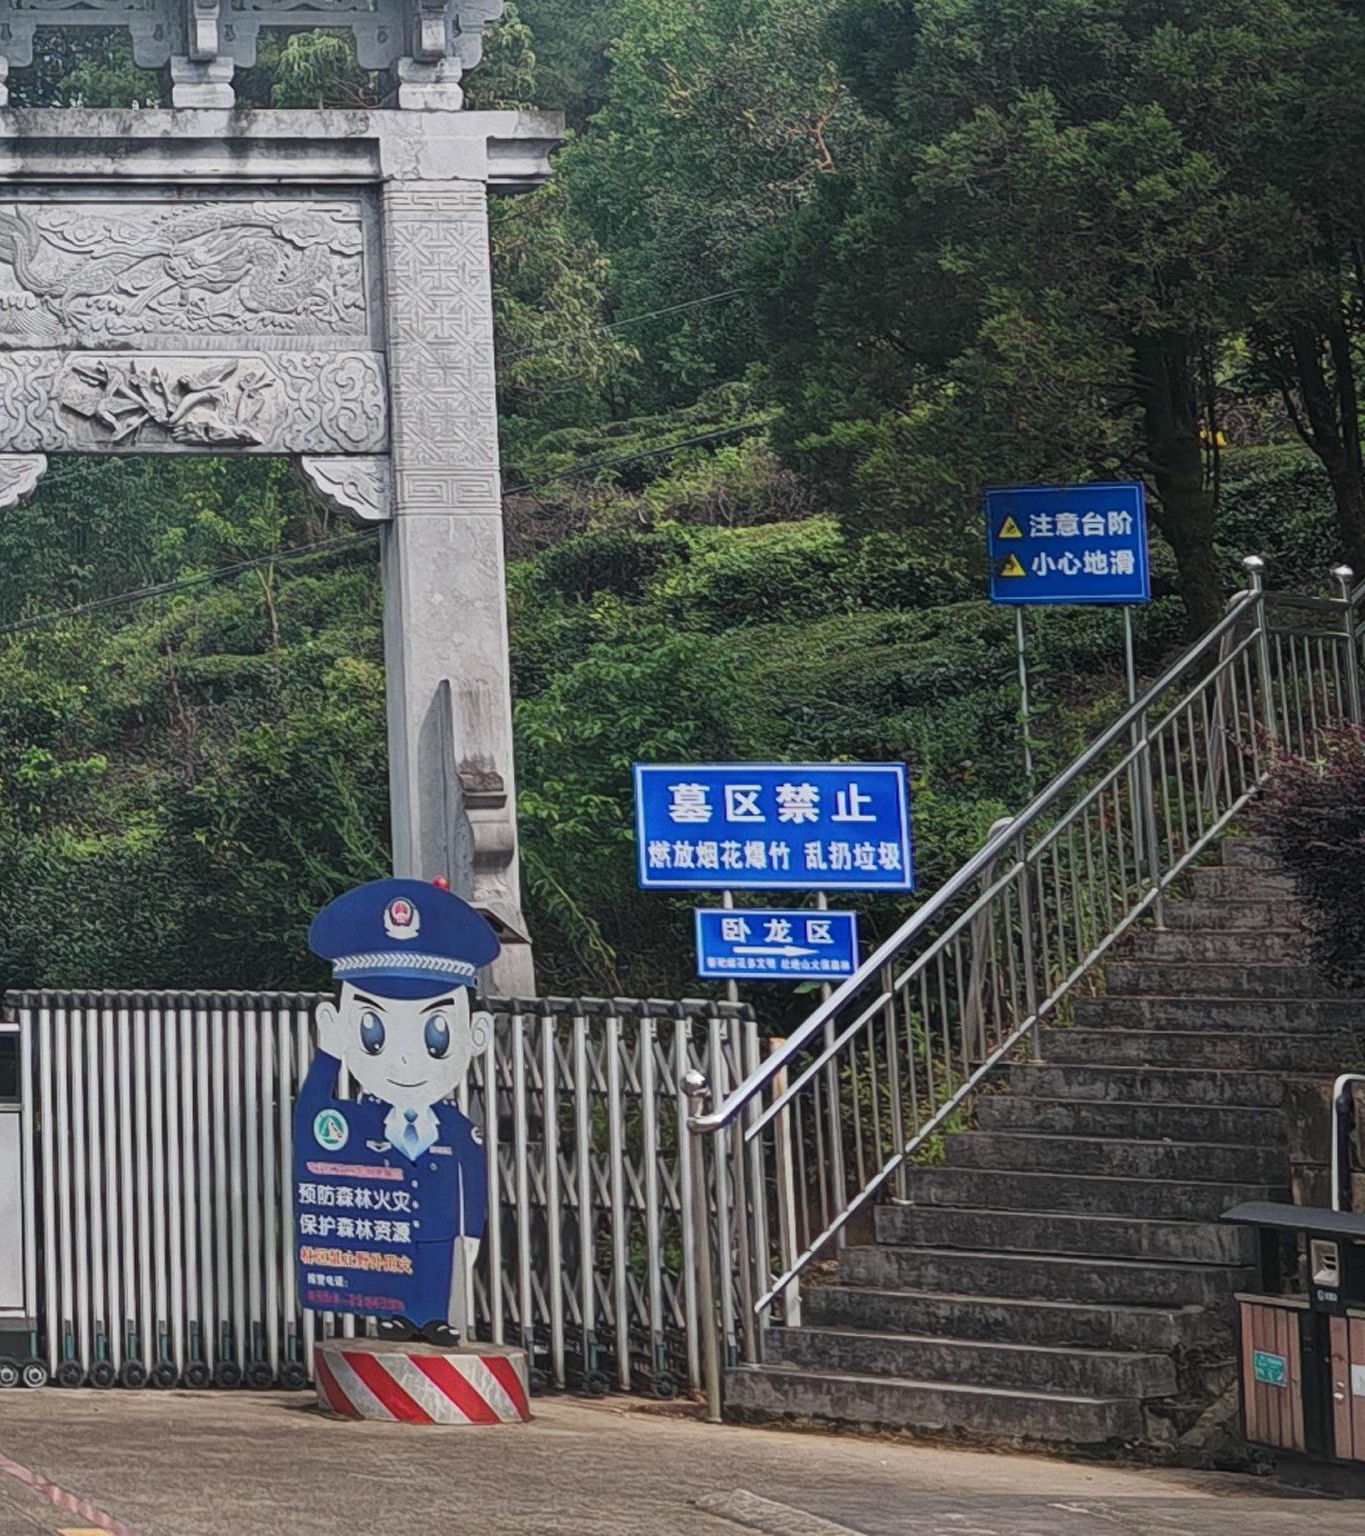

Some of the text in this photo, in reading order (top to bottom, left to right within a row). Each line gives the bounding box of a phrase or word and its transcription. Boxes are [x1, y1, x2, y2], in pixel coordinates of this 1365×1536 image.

[1029, 511, 1133, 537] 注意台阶
[1031, 549, 1135, 576] 小心地滑
[668, 783, 877, 824] 墓区禁止
[647, 840, 901, 871] 燃放烟花爆竹 乱扔垃圾
[721, 917, 835, 944] 卧龙区
[298, 1183, 412, 1213] 预防森林火灾
[299, 1214, 412, 1244] 保护森林资源
